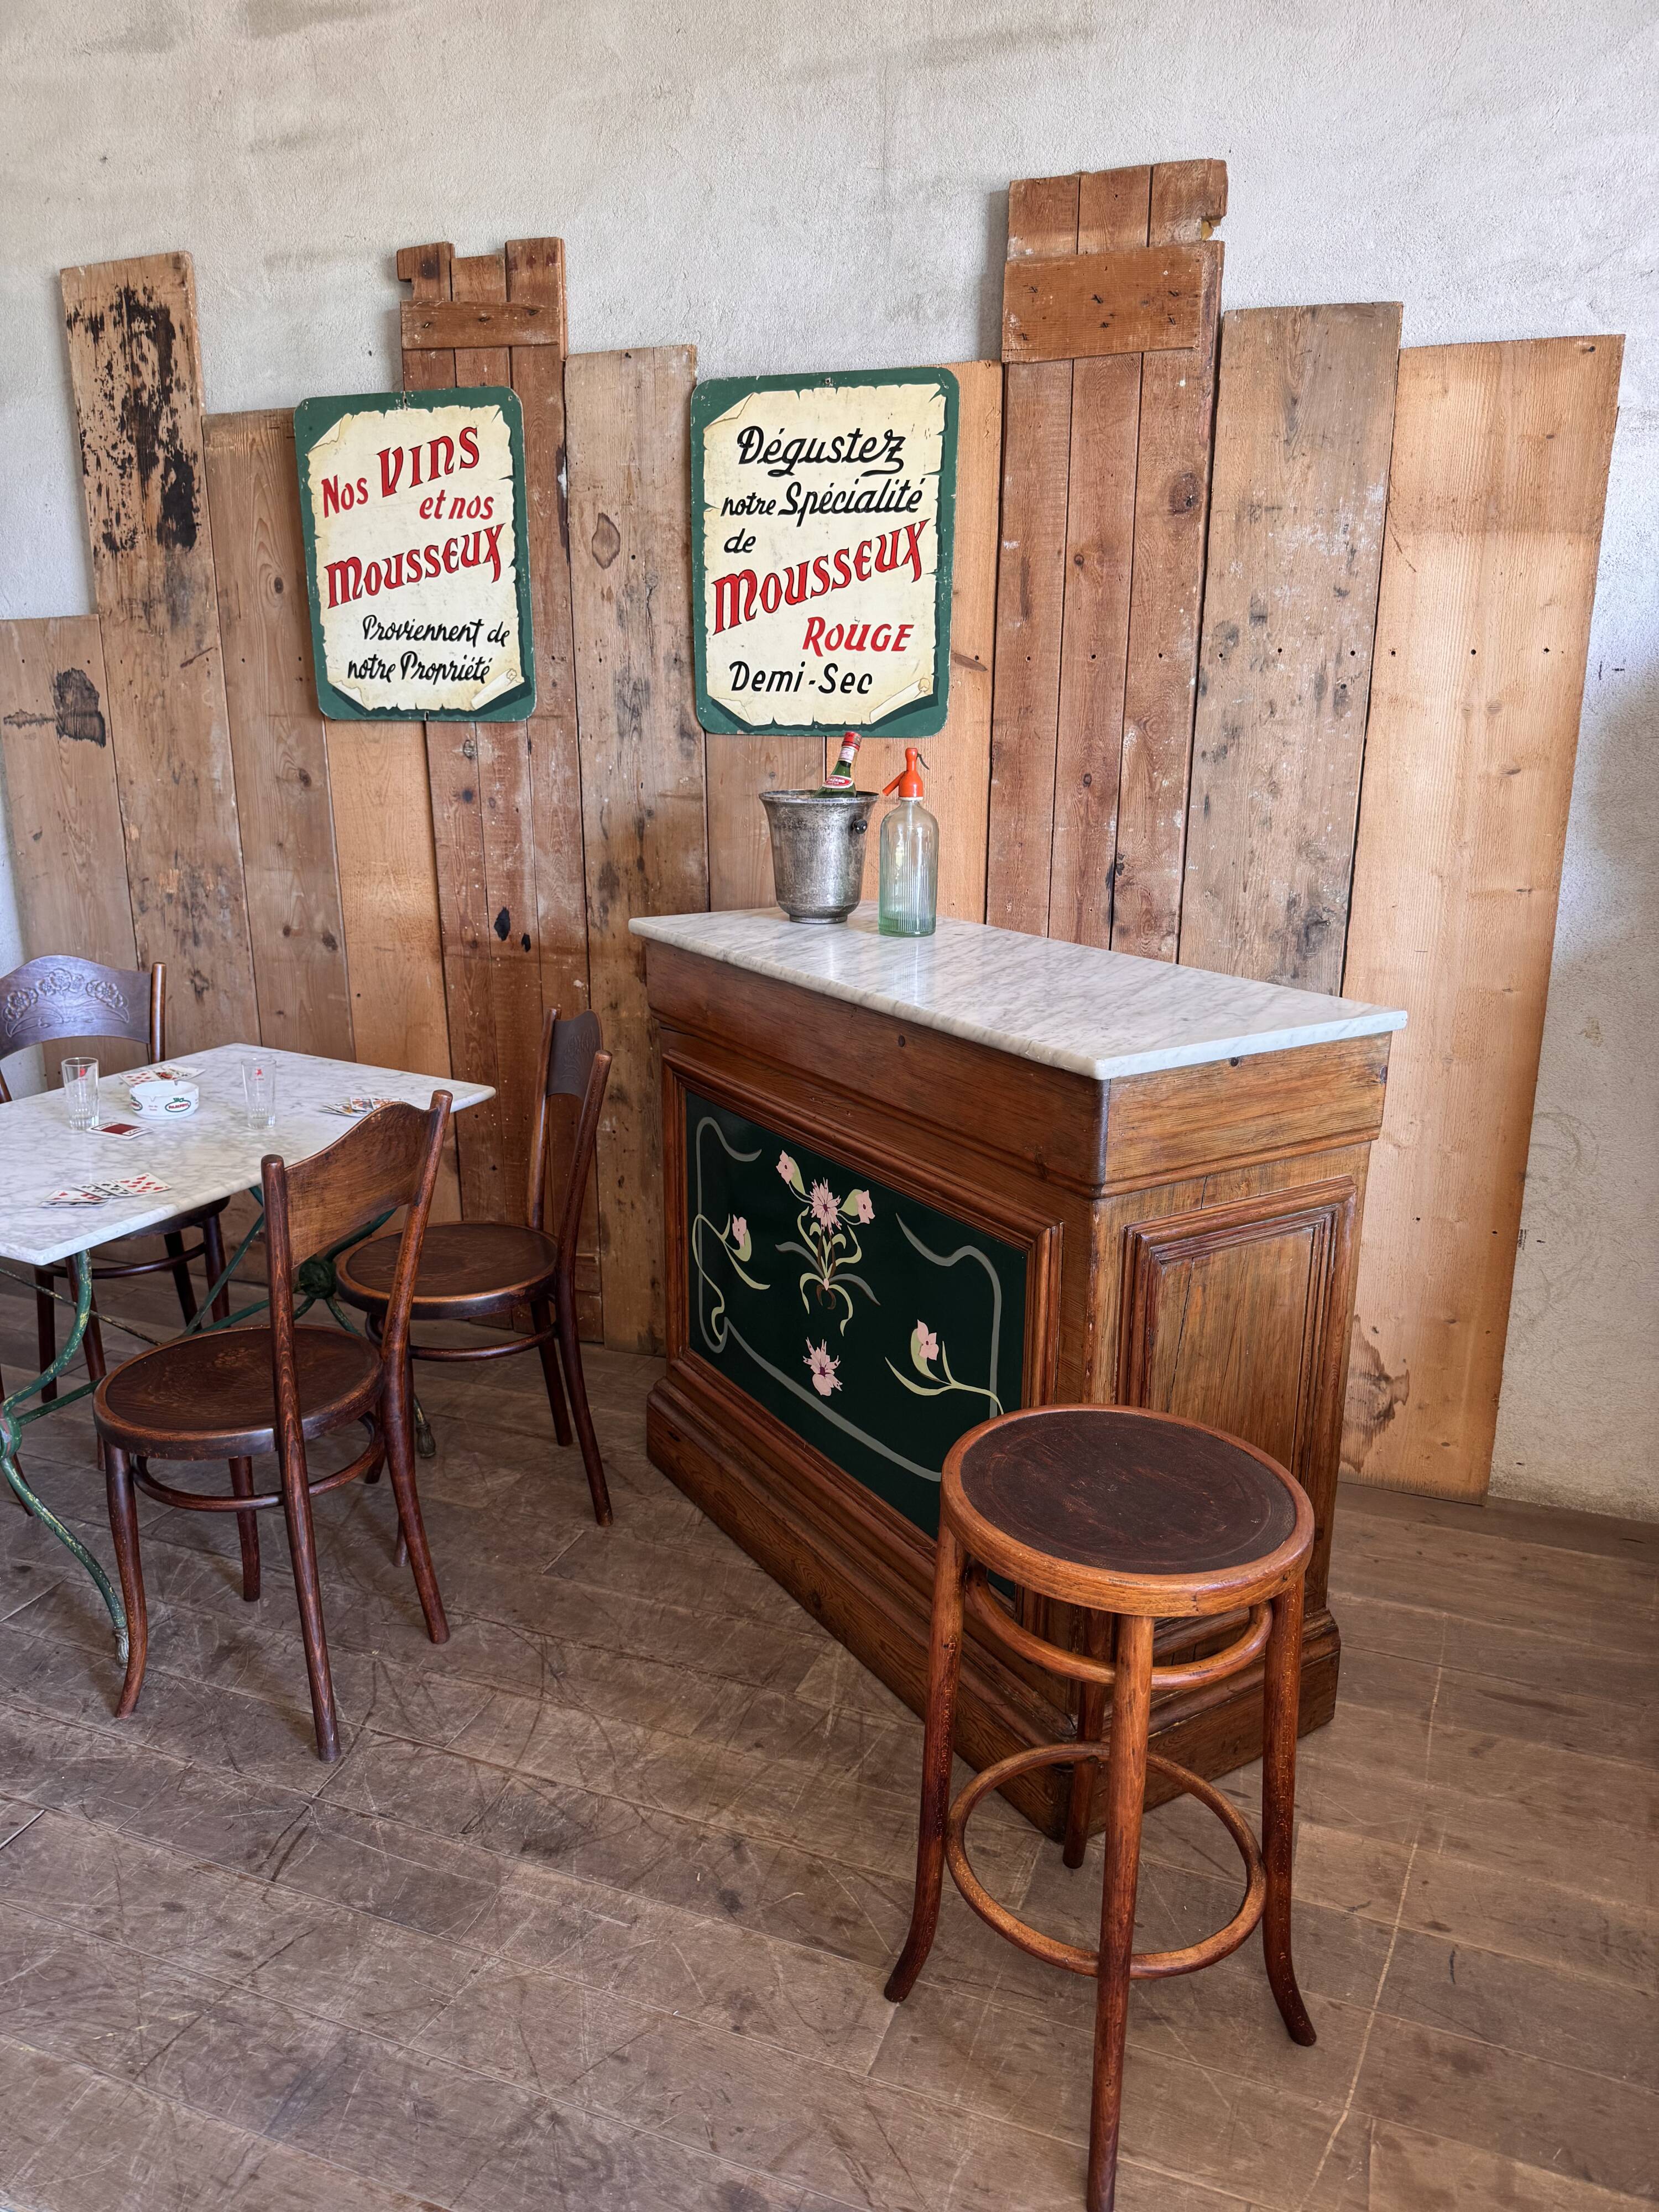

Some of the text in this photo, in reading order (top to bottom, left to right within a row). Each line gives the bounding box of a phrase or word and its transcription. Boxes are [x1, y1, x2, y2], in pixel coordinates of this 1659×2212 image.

[737, 425, 906, 477] Dégustez
[321, 474, 368, 518] Nos
[419, 490, 494, 520] et nos
[720, 478, 926, 528] notre Spécialité
[723, 528, 756, 554] de
[362, 614, 510, 648] Proviennent de
[802, 617, 914, 658] ROUGE
[347, 650, 492, 685] notre Propriété
